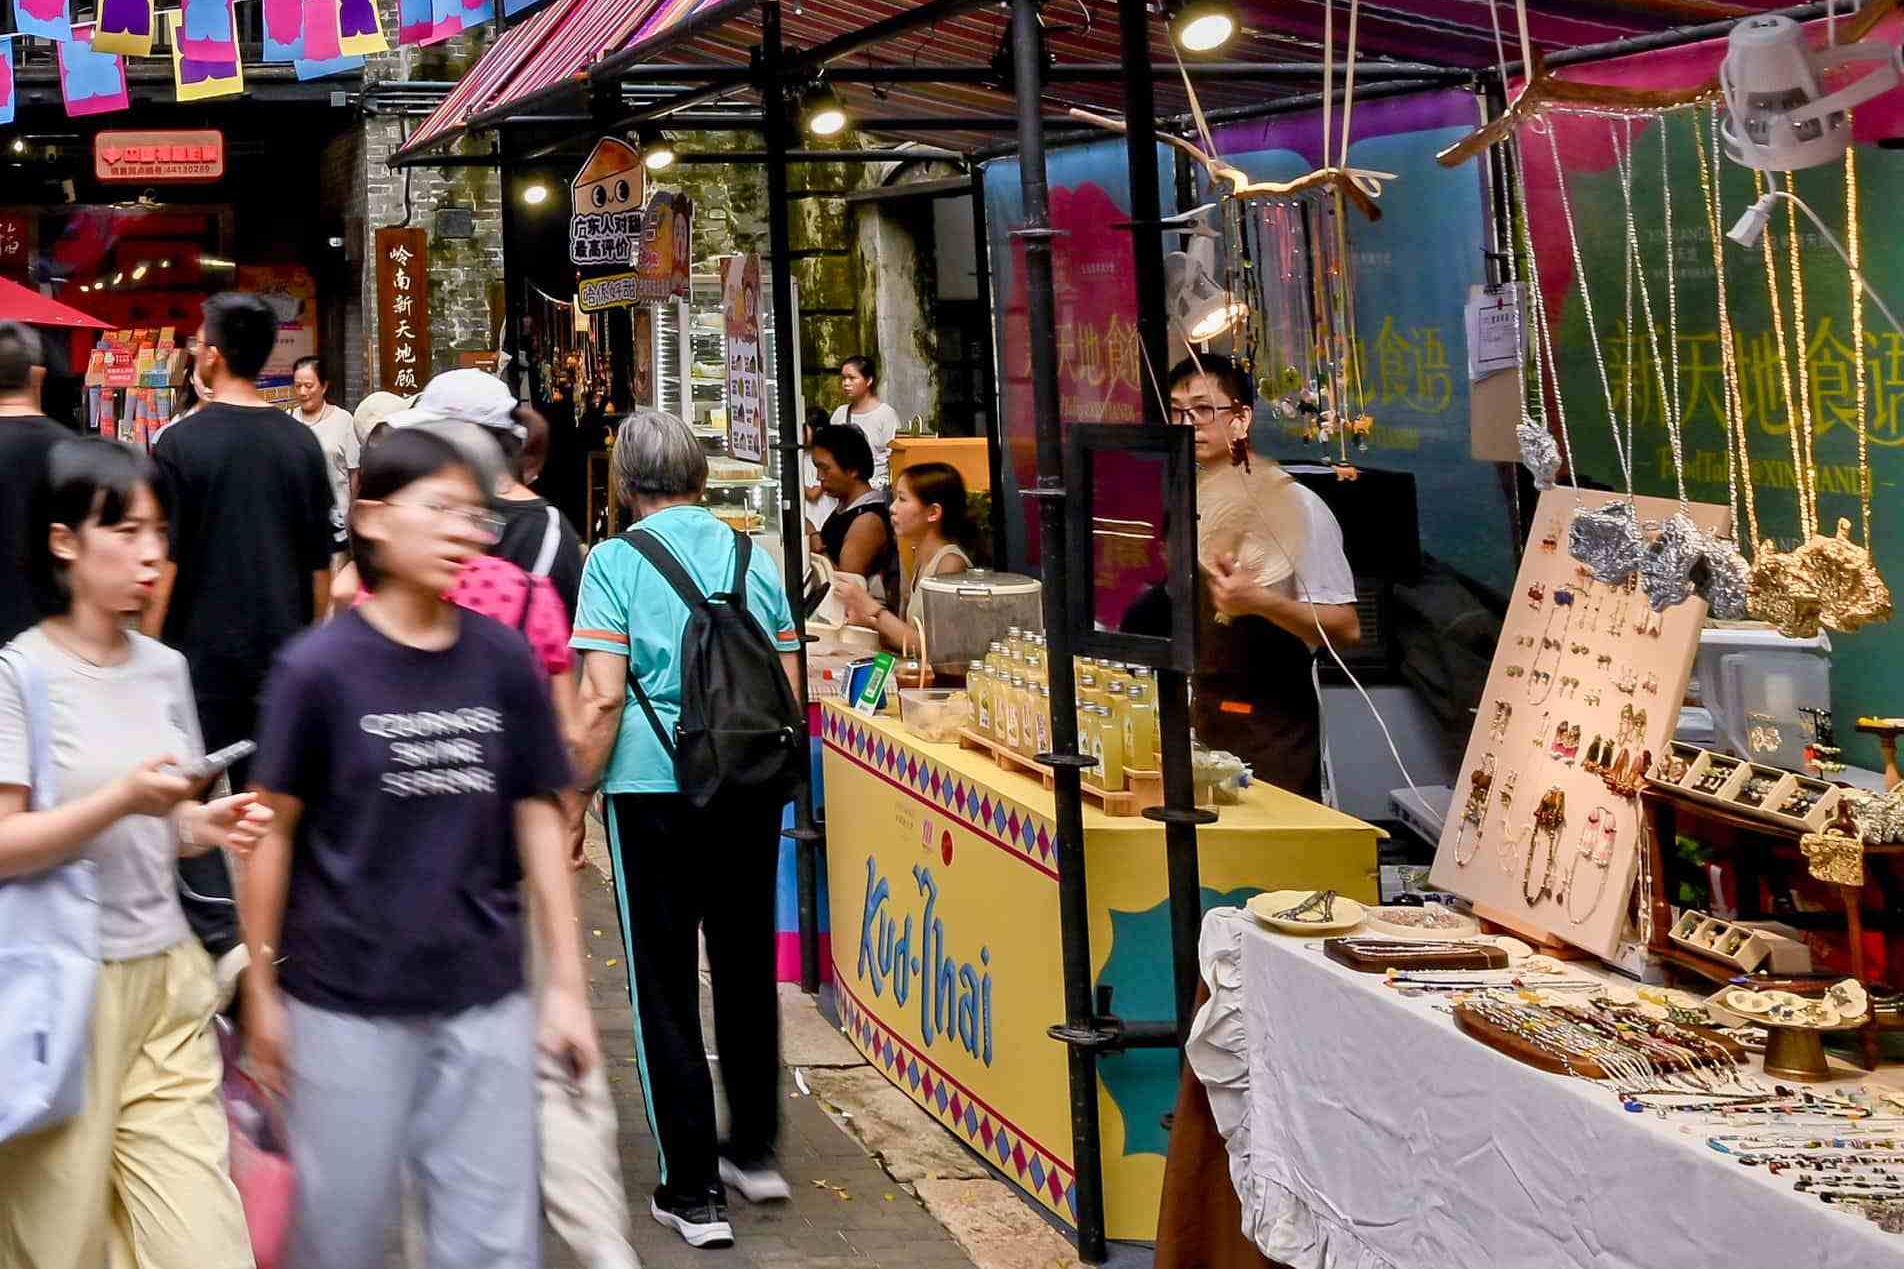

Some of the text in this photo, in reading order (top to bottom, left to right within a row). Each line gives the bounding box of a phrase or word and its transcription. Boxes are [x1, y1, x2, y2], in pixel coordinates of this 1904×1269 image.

[388, 243, 419, 398] 岭南新天地顾
